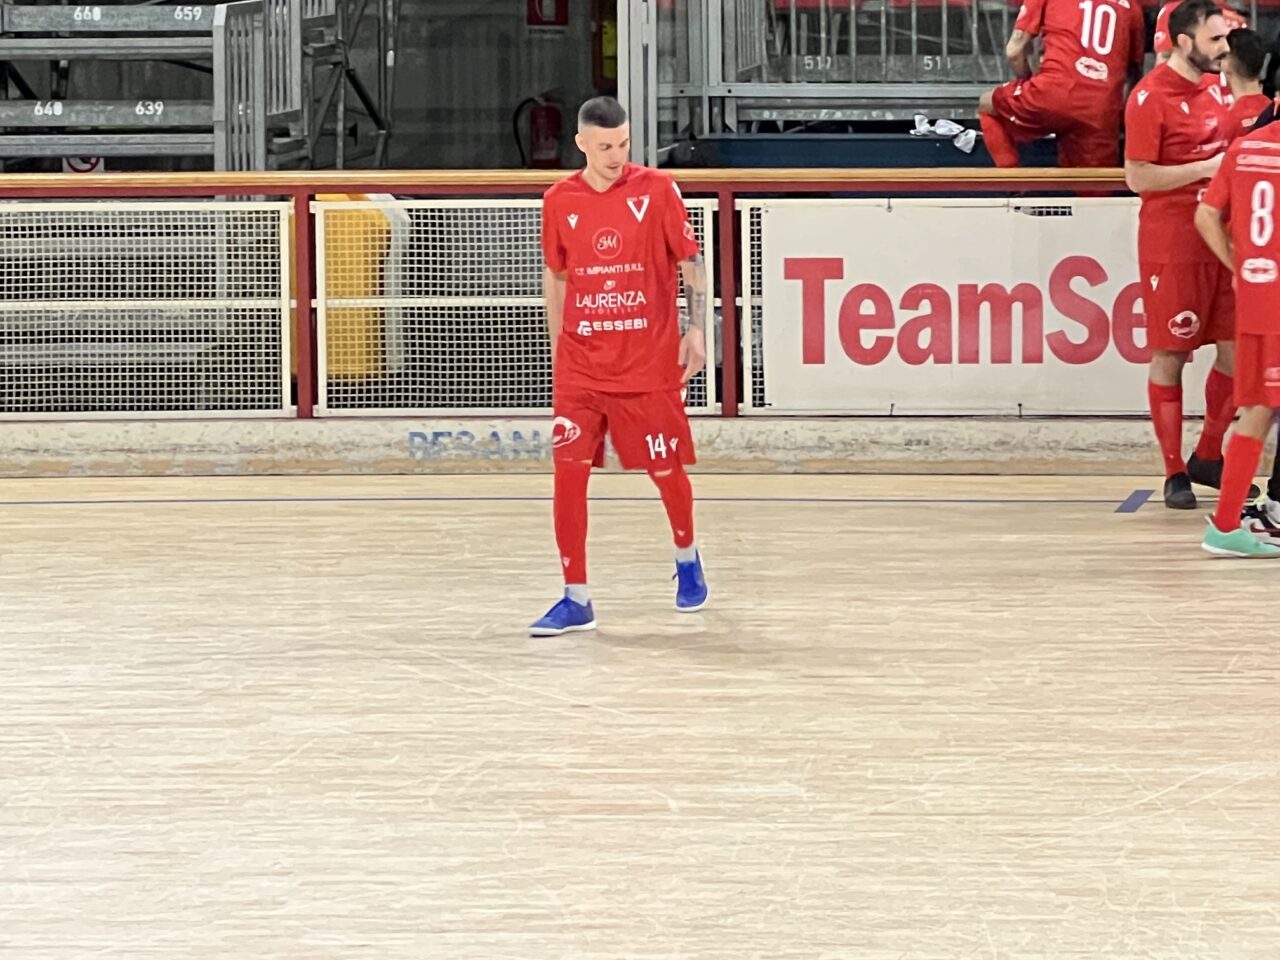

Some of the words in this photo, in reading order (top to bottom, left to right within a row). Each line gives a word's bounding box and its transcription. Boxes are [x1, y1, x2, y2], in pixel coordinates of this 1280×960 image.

[174, 6, 202, 21] 659
[1079, 0, 1117, 55] 10
[923, 55, 951, 70] 51
[135, 101, 164, 116] 639
[1251, 180, 1275, 247] 8
[576, 290, 647, 308] LAURENZA
[592, 318, 648, 331] ESSEBI
[646, 433, 667, 460] 14
